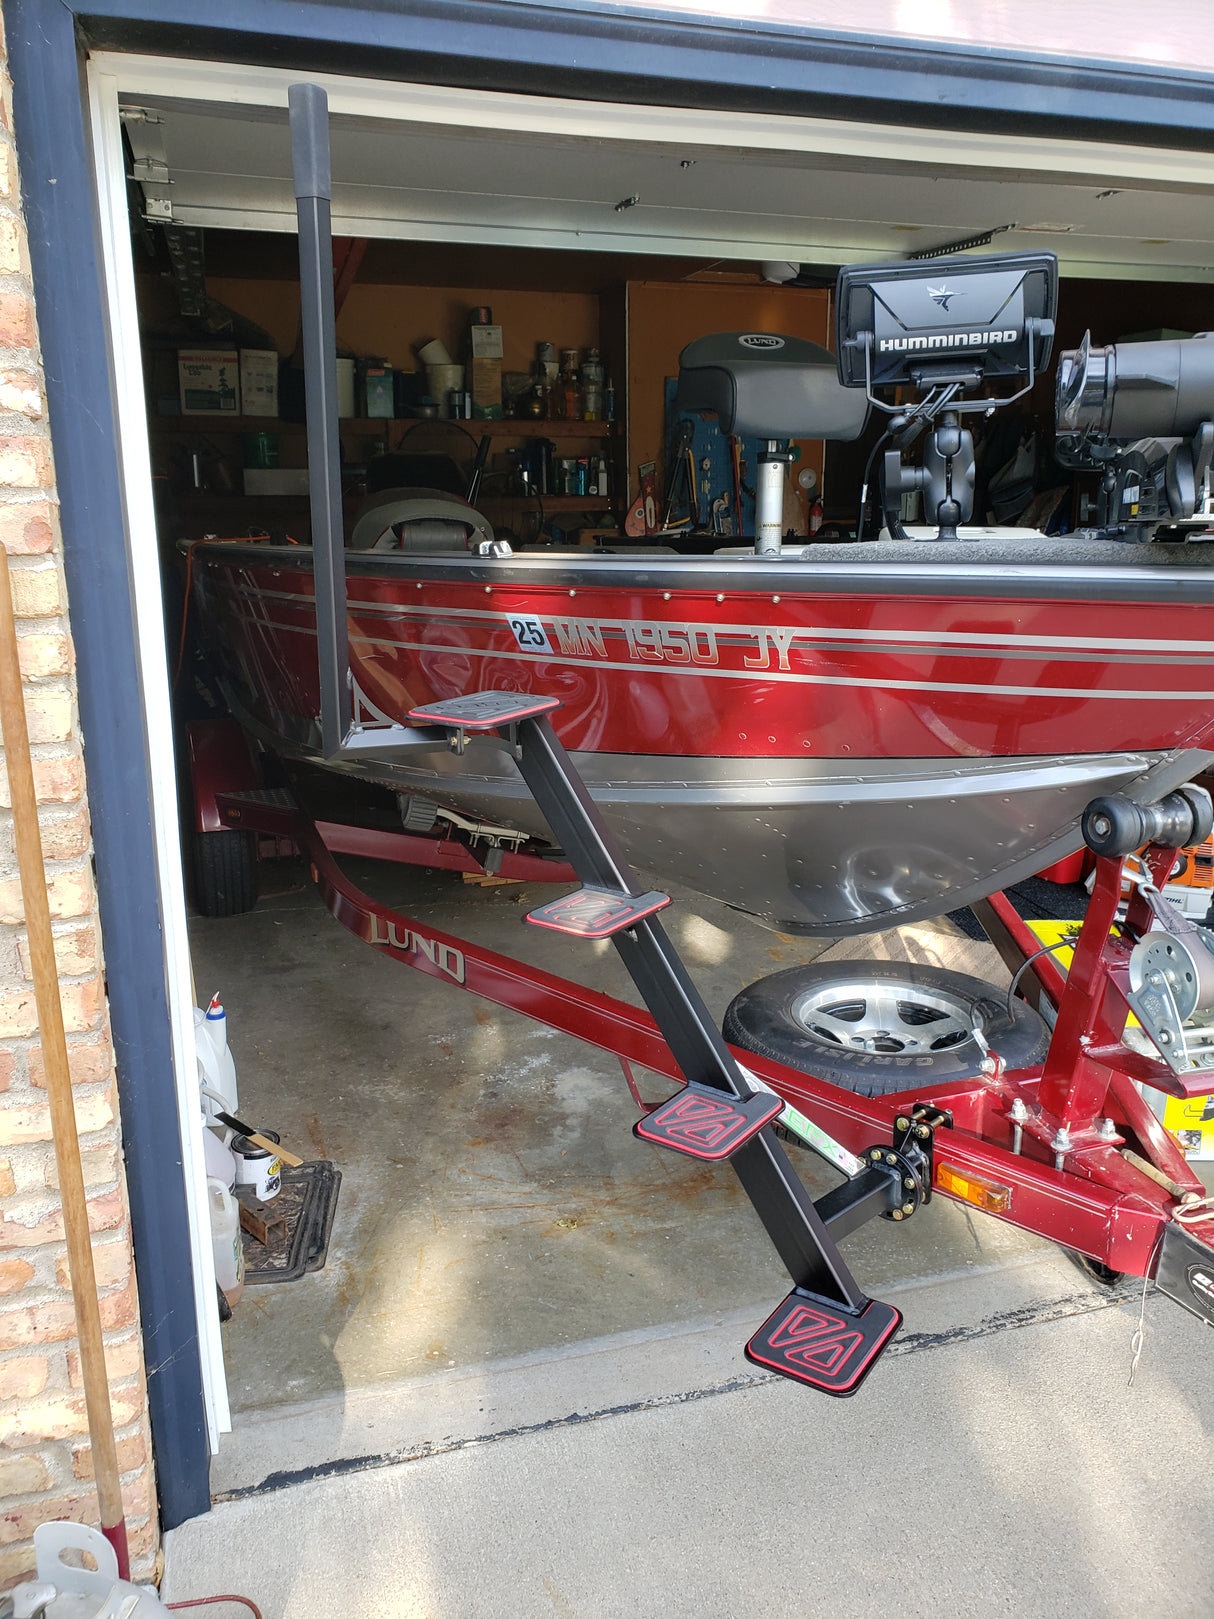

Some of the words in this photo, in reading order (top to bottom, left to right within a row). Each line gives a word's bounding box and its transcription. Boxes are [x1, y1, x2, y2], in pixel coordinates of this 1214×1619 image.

[747, 337, 777, 346] LUND
[880, 330, 1017, 351] HUMMINBIRD
[511, 620, 545, 646] 25
[552, 617, 608, 657] MN
[621, 621, 719, 664] 1950
[743, 626, 796, 670] JY
[1164, 897, 1184, 905] TIHL
[369, 911, 466, 986] LUND
[792, 1039, 934, 1066] CARLISLE
